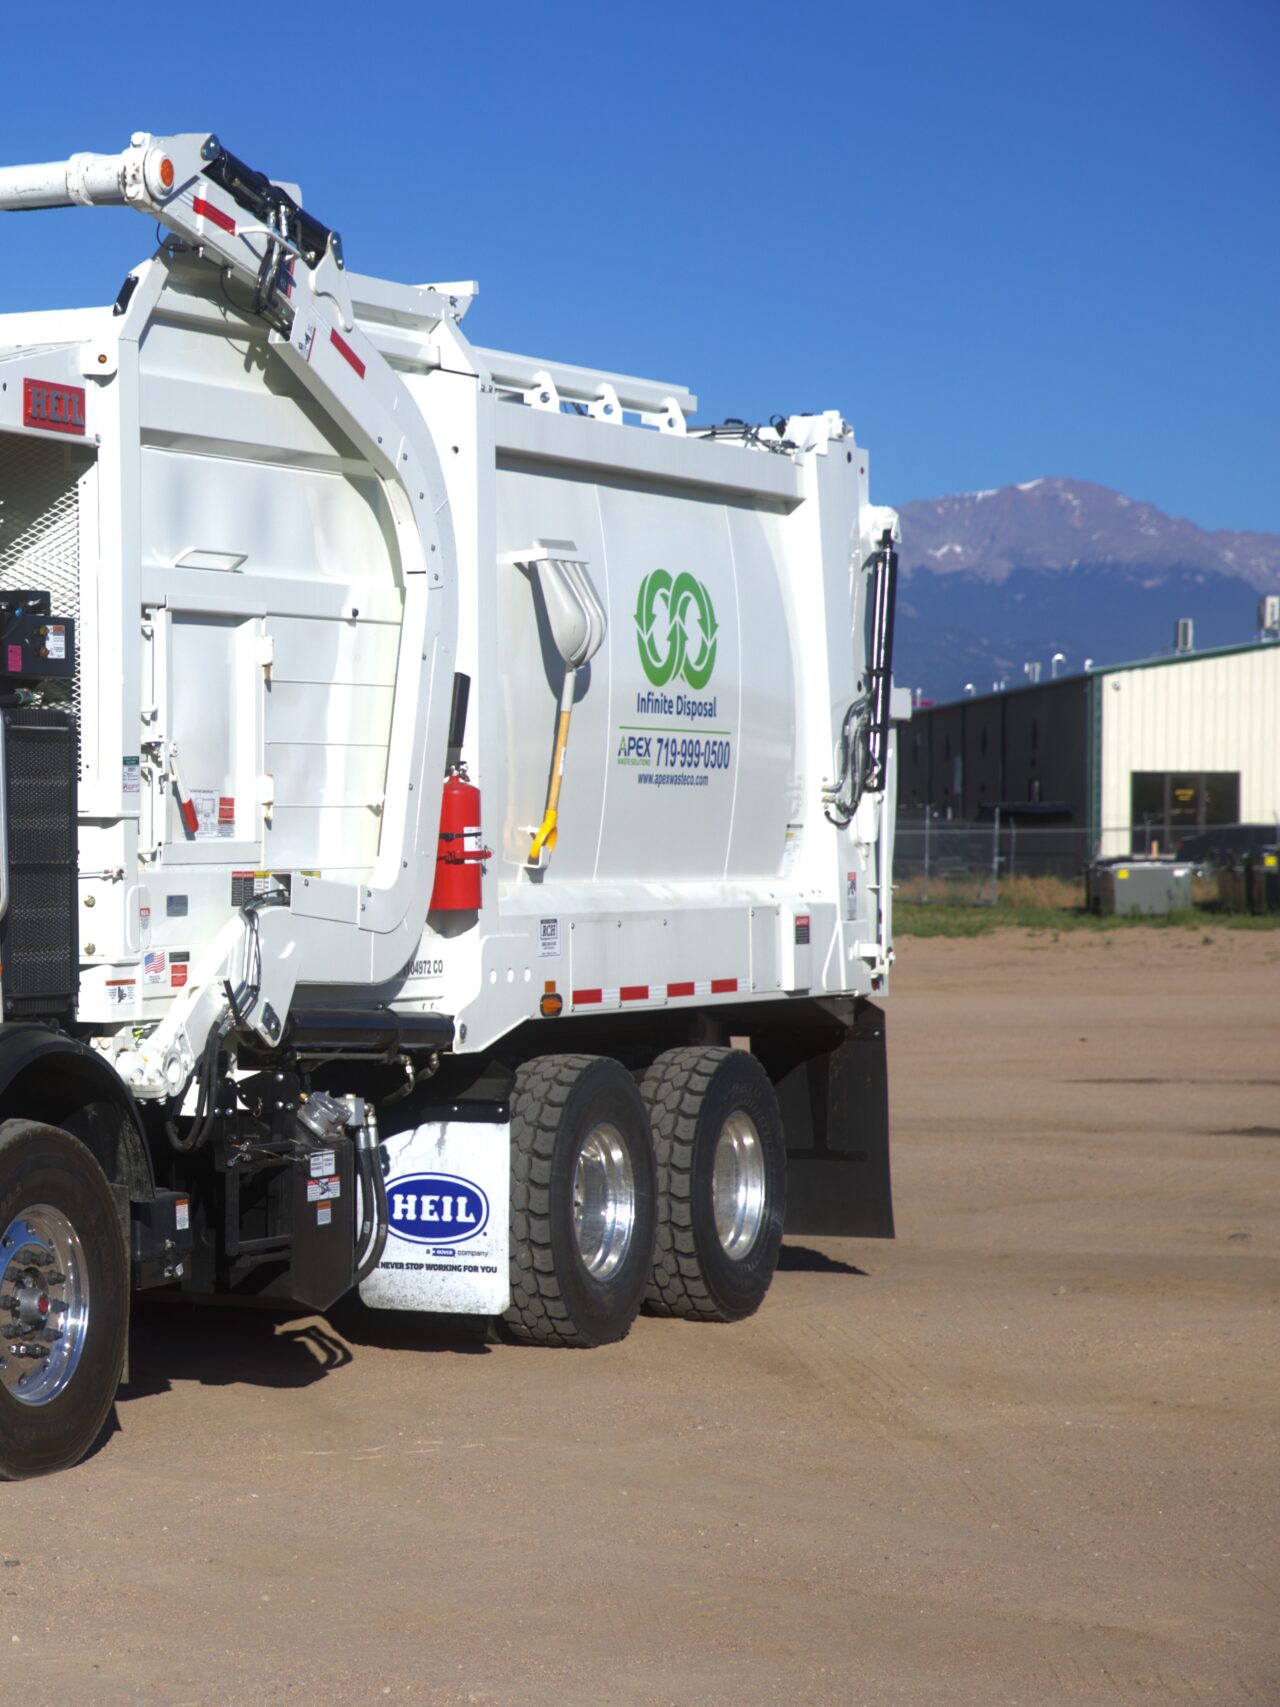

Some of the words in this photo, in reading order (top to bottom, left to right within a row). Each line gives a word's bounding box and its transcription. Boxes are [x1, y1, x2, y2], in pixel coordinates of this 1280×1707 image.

[31, 386, 84, 427] HEIL
[637, 691, 673, 715] Infinite
[676, 695, 717, 721] Disposal
[618, 735, 652, 758] APEX
[656, 738, 731, 769] 719-999-0500
[638, 773, 709, 787] www.apexwasteco.com
[433, 959, 444, 974] CO
[392, 1193, 476, 1223] HEIL
[457, 1250, 489, 1258] company
[425, 1264, 462, 1272] WORKING
